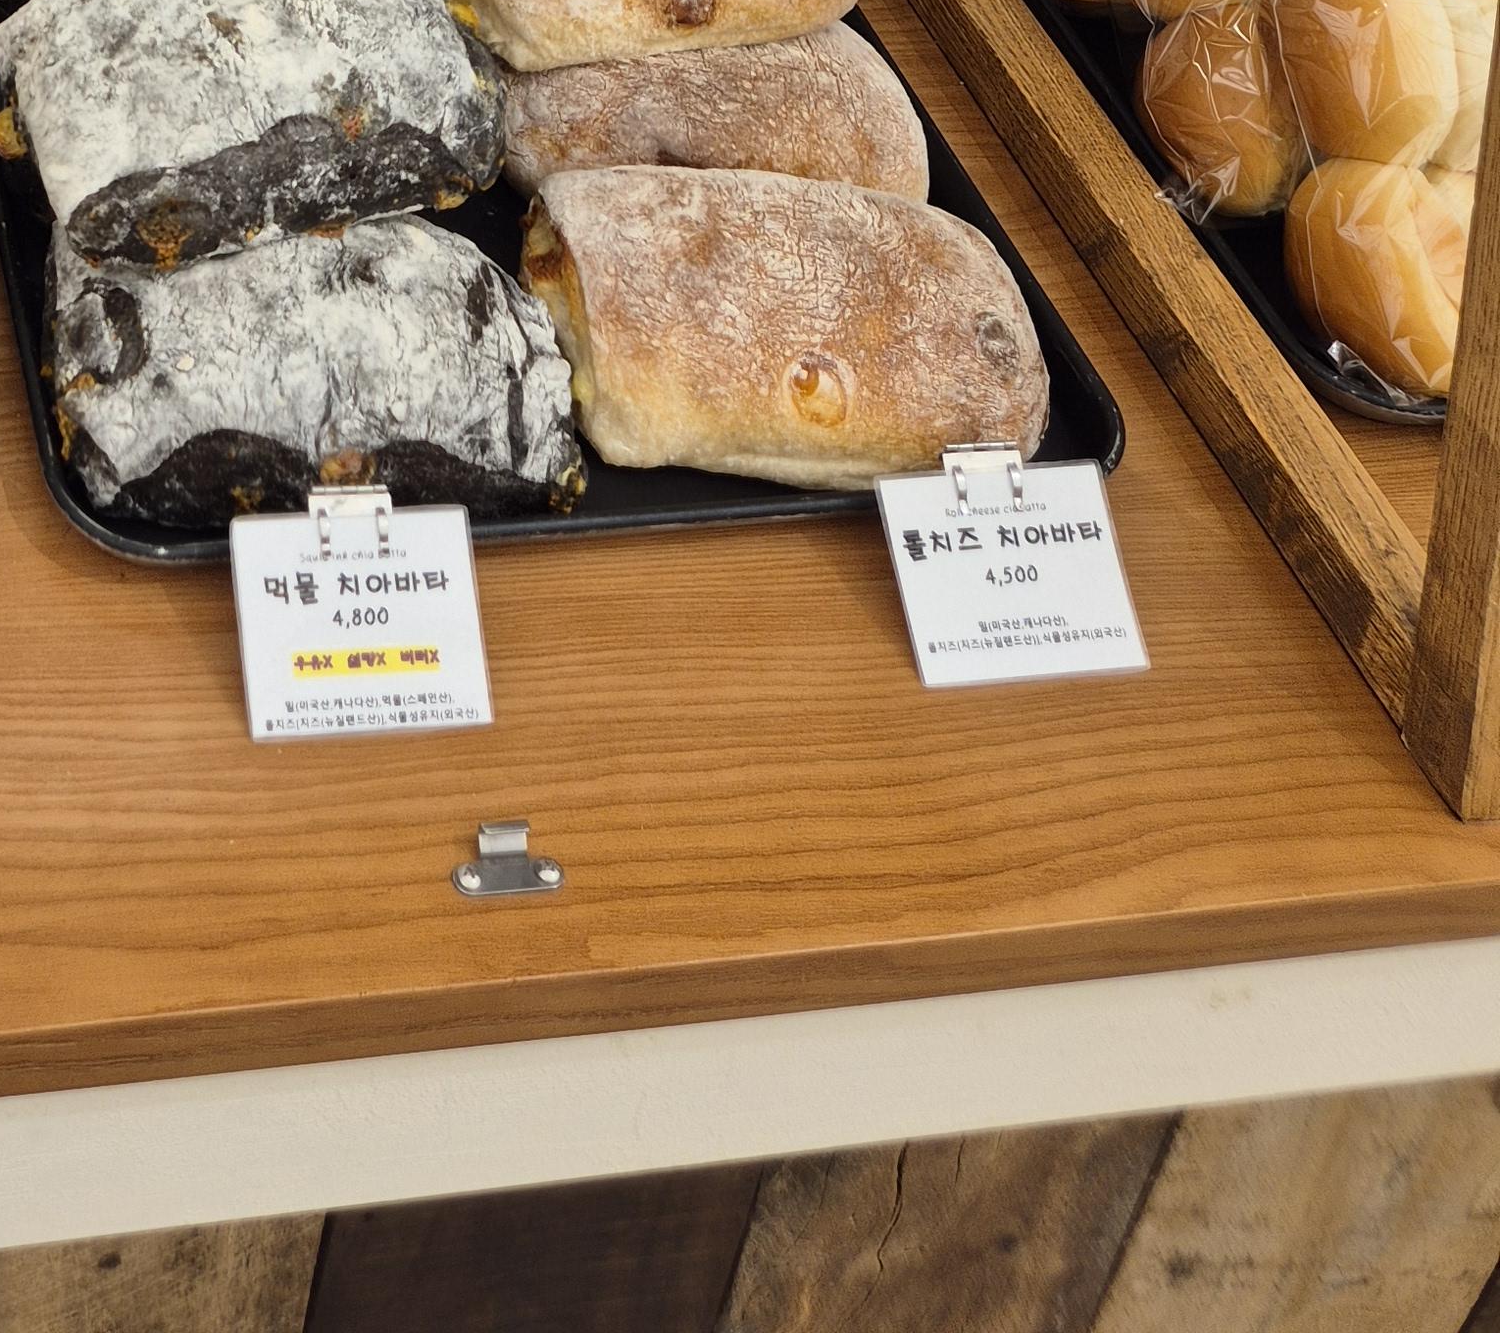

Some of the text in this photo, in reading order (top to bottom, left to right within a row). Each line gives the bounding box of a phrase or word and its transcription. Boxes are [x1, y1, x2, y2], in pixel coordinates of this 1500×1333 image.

[903, 520, 1102, 562] 롤치즈 치아바타
[264, 569, 449, 605] 먹물 치아바타
[986, 564, 1038, 587] 4,500
[332, 606, 389, 629] 4,800
